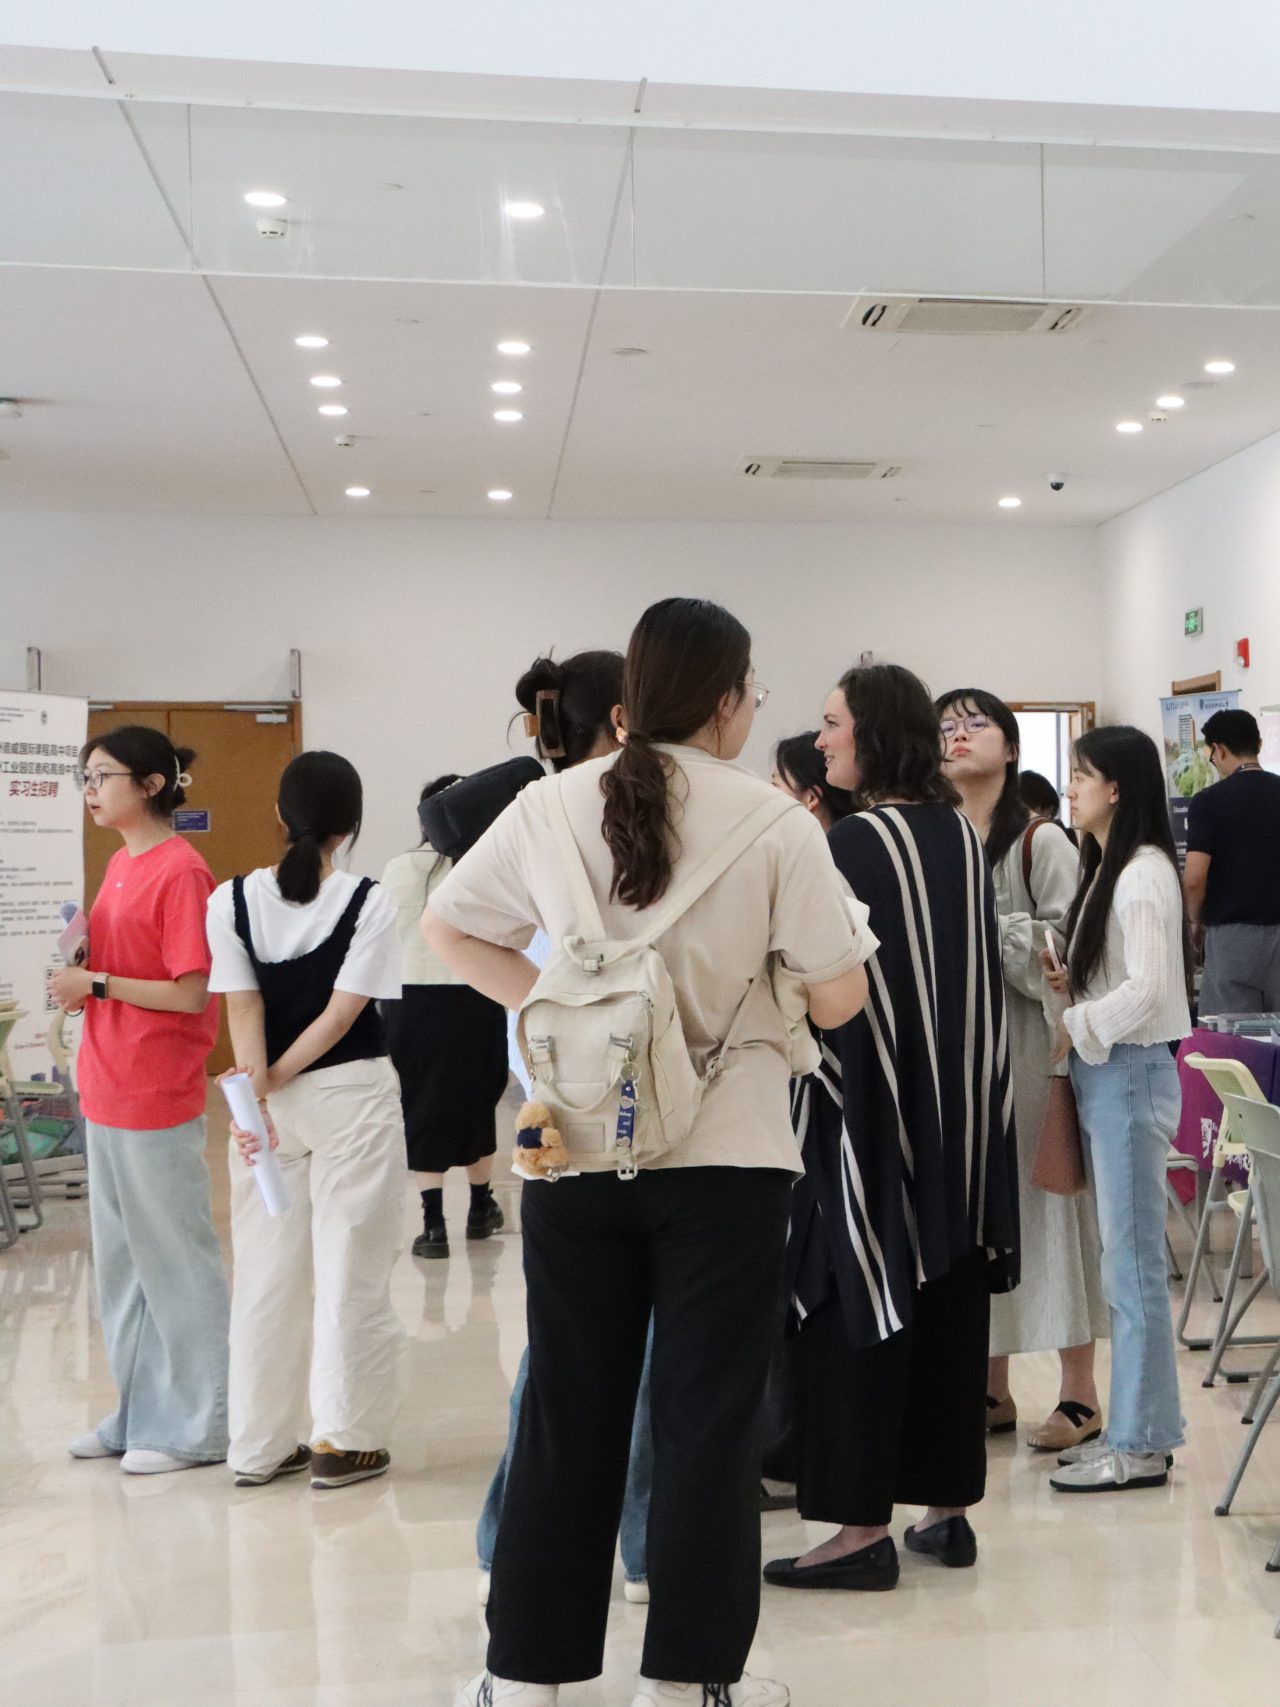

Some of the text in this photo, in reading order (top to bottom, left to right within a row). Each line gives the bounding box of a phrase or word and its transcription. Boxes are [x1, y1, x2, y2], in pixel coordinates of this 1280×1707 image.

[9, 780, 59, 798] 实习生招聘
